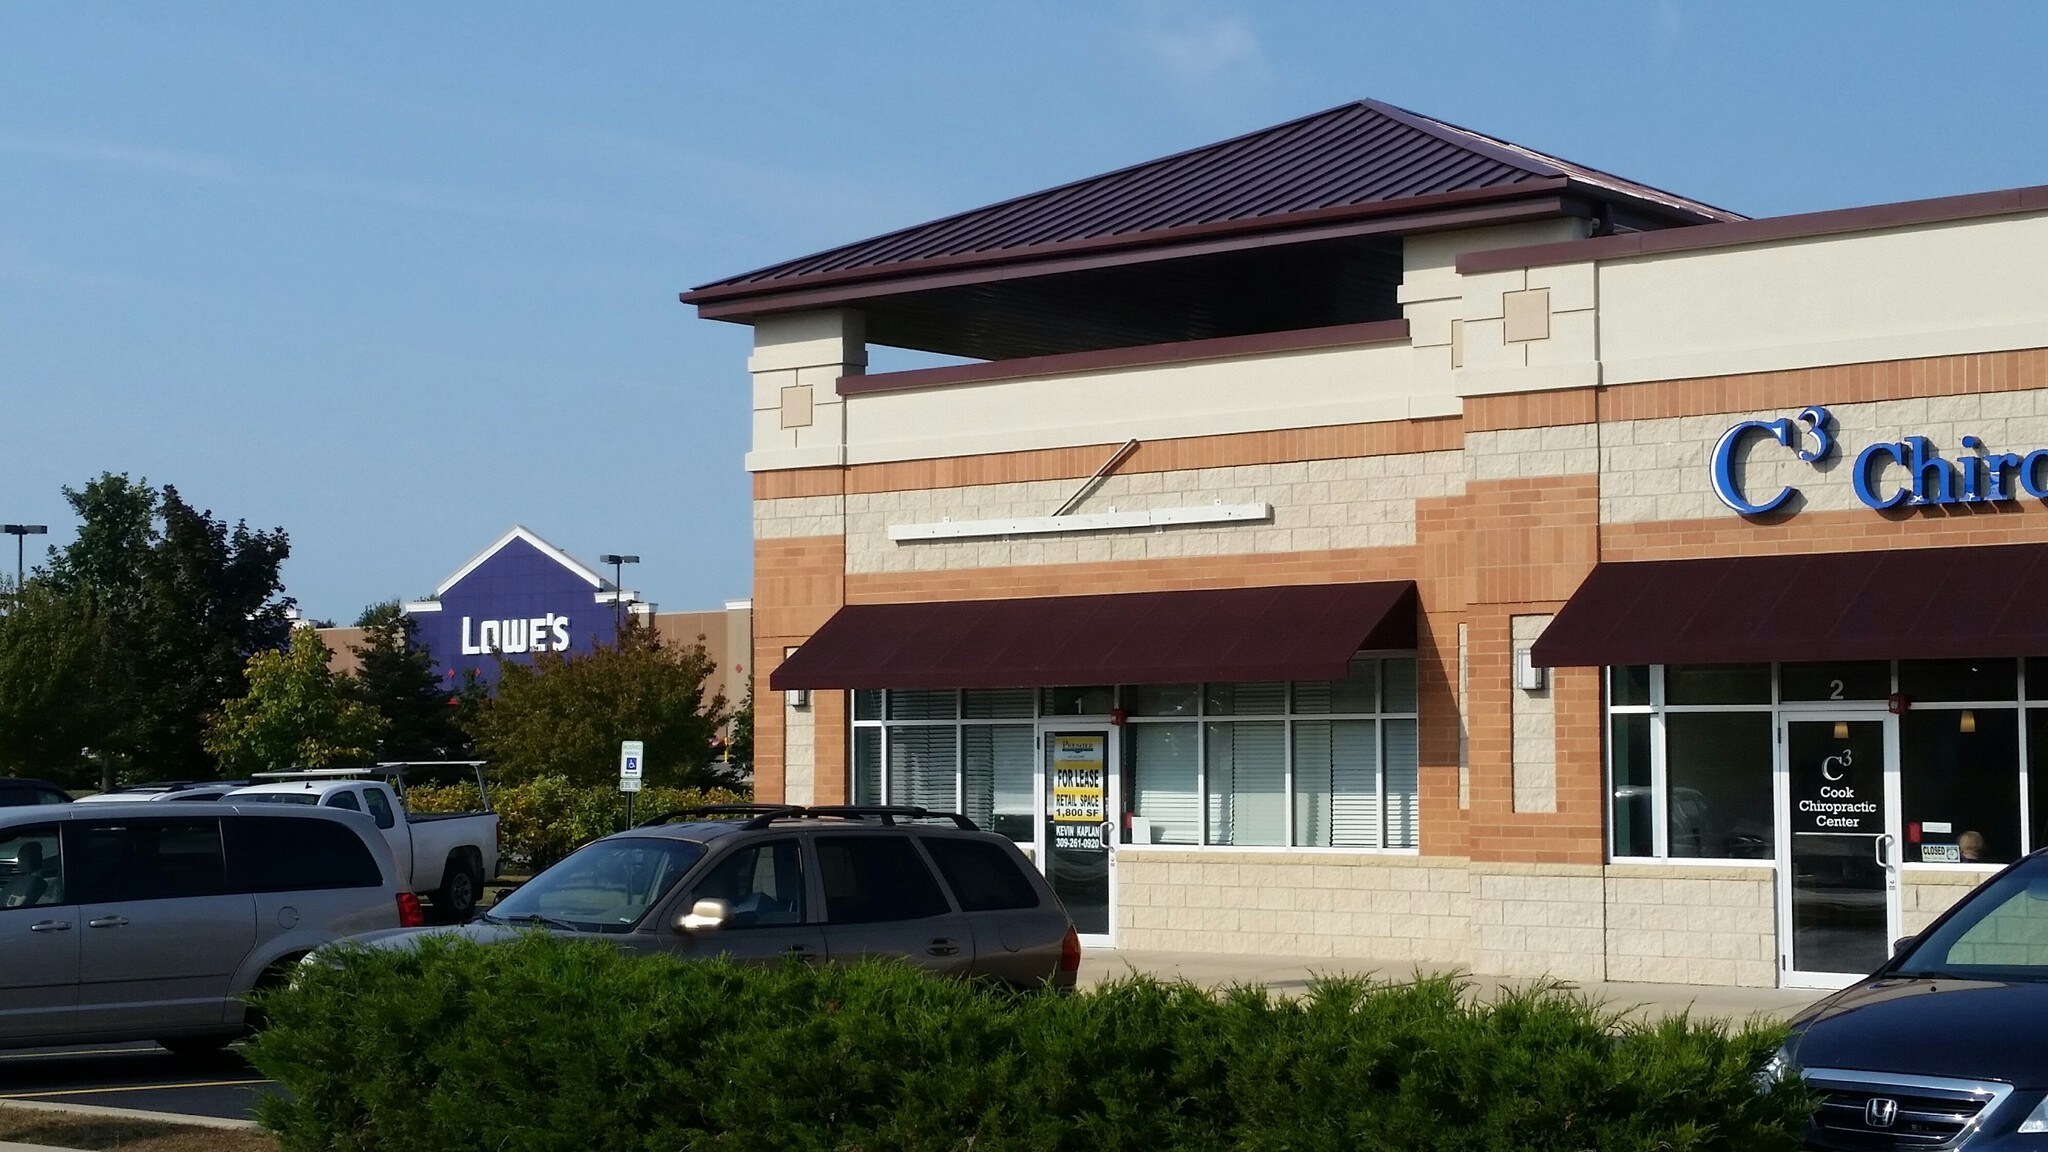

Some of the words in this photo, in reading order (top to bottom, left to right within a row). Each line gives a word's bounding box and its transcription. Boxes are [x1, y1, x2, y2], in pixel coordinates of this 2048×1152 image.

[462, 612, 570, 655] LOWE'S
[1830, 679, 1844, 700] 2
[1074, 698, 1082, 714] 1
[1057, 769, 1073, 788] FOR
[1075, 769, 1099, 788] LEASE
[1820, 786, 1855, 799] Cook
[1056, 794, 1077, 807] RETAIL
[1080, 794, 1099, 807] SPACE
[1799, 800, 1877, 814] Chiropractic
[1056, 808, 1083, 818] 1,800
[1086, 808, 1099, 817] SF
[1816, 815, 1860, 828] Center
[1055, 825, 1075, 837] KEVIN
[1076, 825, 1100, 837] KAPLAN
[1055, 837, 1100, 849] 309-261-0920
[1923, 846, 1946, 856] CLOSED
